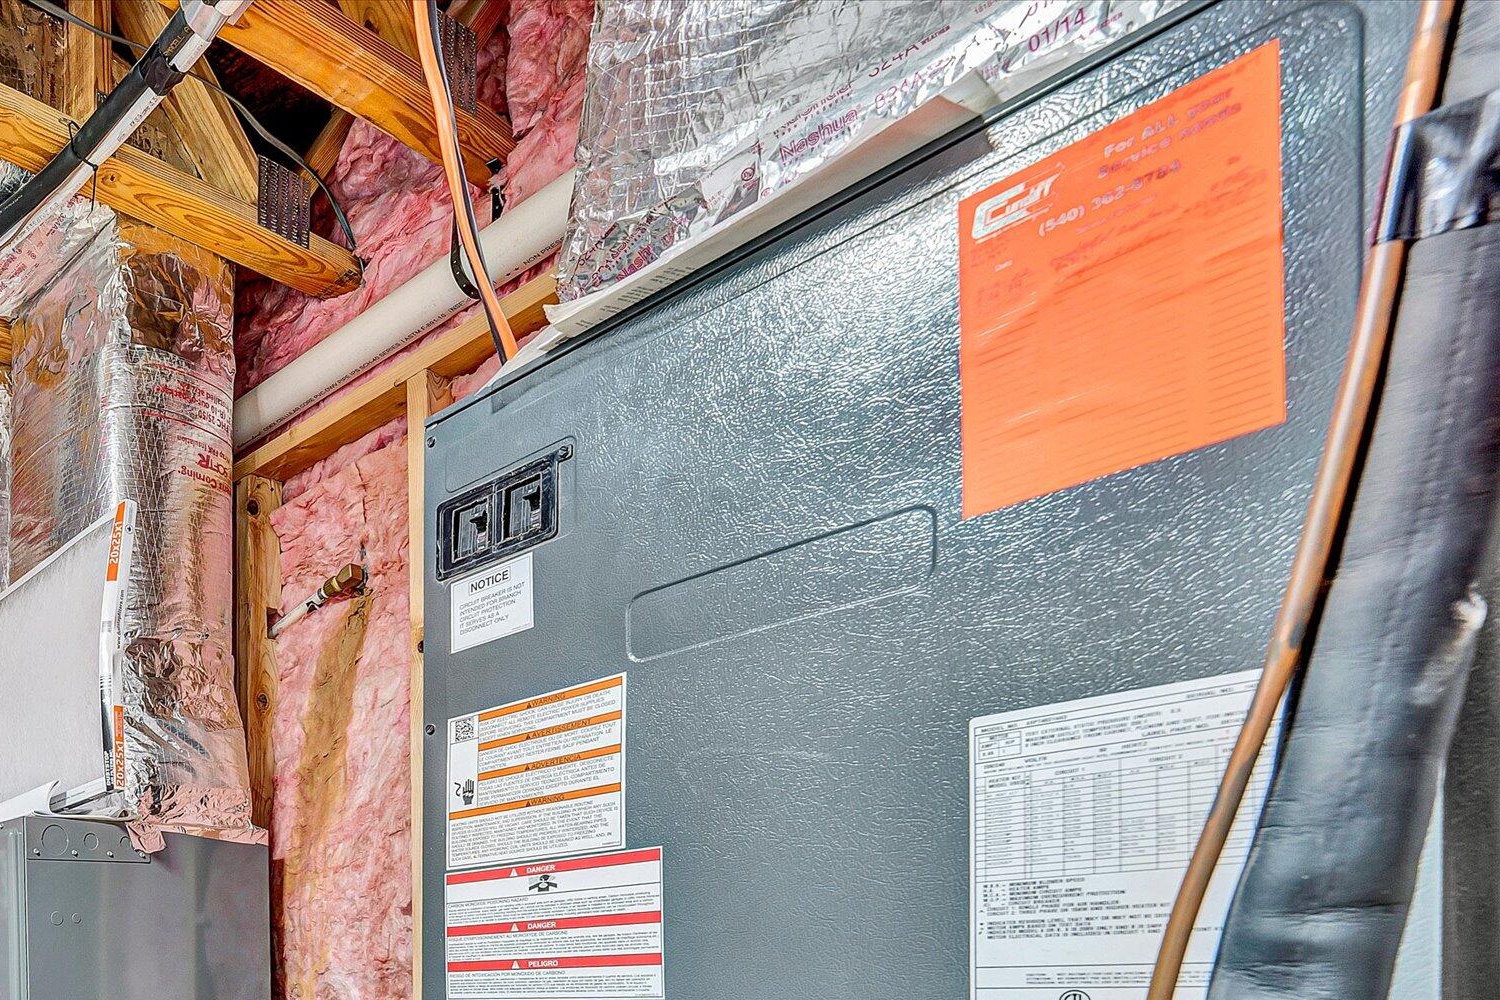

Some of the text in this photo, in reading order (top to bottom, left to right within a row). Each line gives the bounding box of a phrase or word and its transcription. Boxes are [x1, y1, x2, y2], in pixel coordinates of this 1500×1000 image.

[1028, 7, 1086, 52] 01/14
[779, 108, 858, 162] Nashua
[523, 252, 541, 266] NON
[177, 435, 206, 451] Insulation
[181, 466, 217, 487] Corning
[108, 520, 124, 566] 20x25x1
[470, 569, 509, 593] NOTICE
[531, 691, 566, 707] WARNING
[531, 718, 591, 738] AVERTISSEMENT
[116, 740, 125, 787] 20x25x1
[531, 753, 581, 769] ADVERTENCIA
[530, 794, 565, 807] WARNING
[525, 863, 556, 874] DANGER
[527, 920, 557, 930] DANGER
[527, 959, 558, 968] PELIGRO
